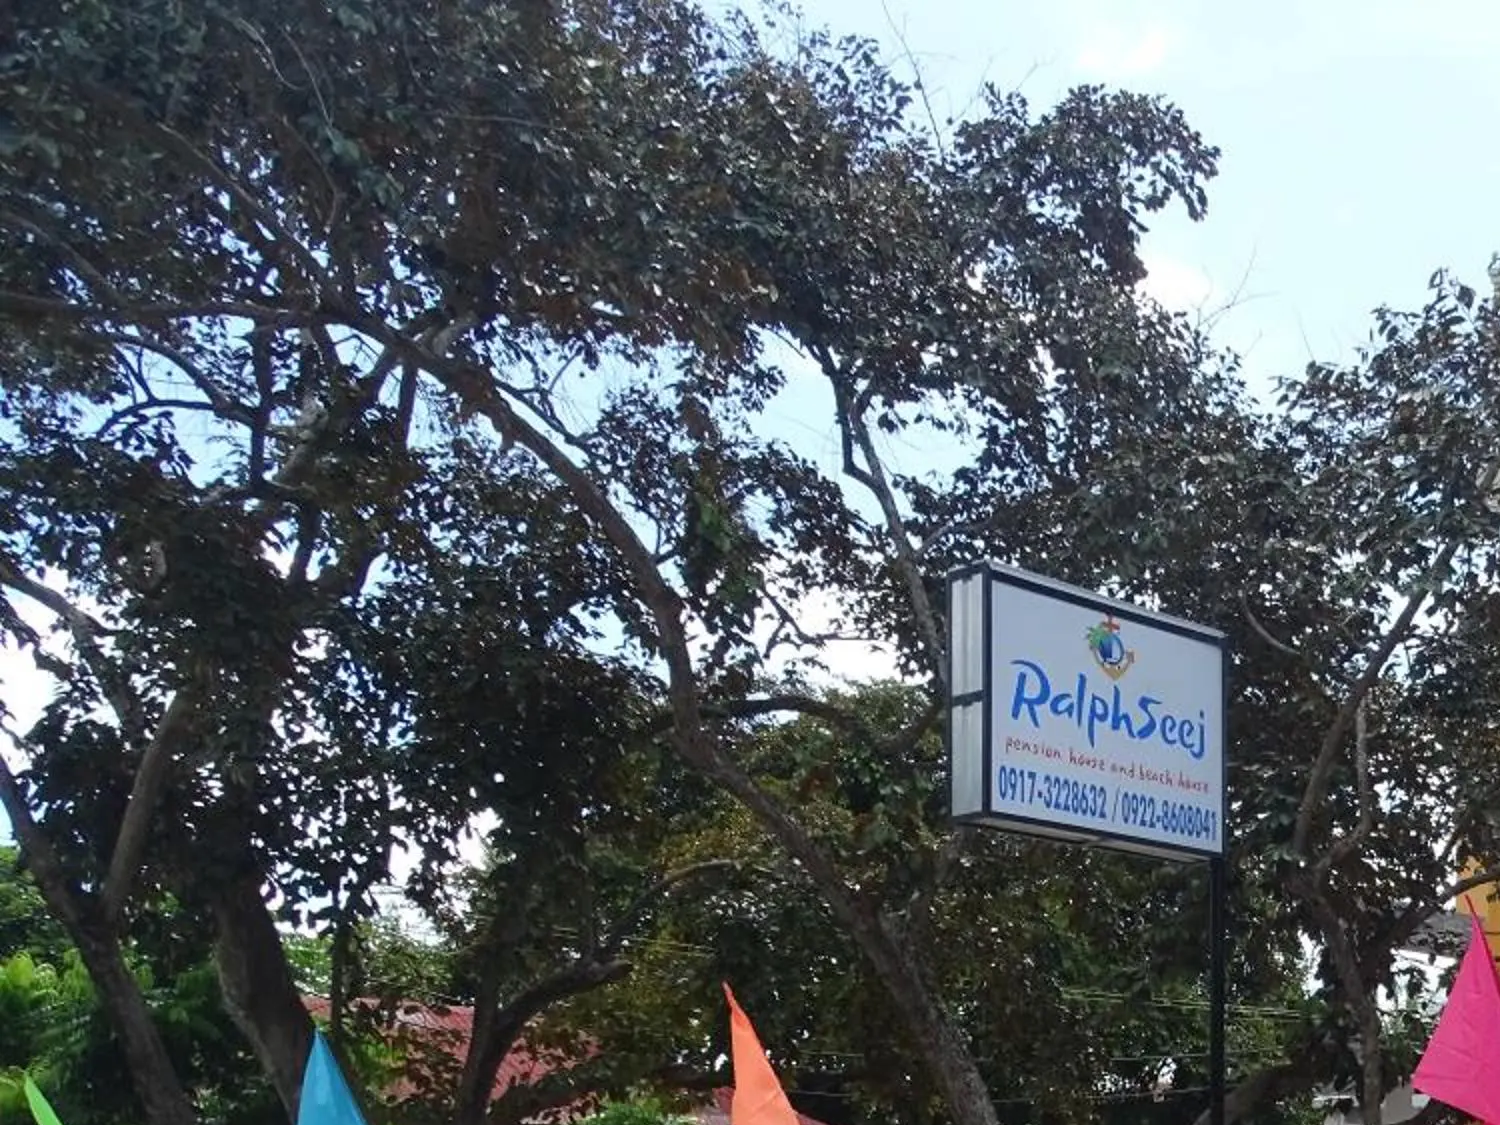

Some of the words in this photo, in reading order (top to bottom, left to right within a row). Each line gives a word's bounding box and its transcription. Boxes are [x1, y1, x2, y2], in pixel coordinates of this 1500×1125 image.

[1005, 737, 1061, 760] pension
[1069, 746, 1105, 771] house
[1111, 761, 1135, 779] and
[1139, 764, 1173, 787] beach
[999, 765, 1107, 819] 0917-3228632
